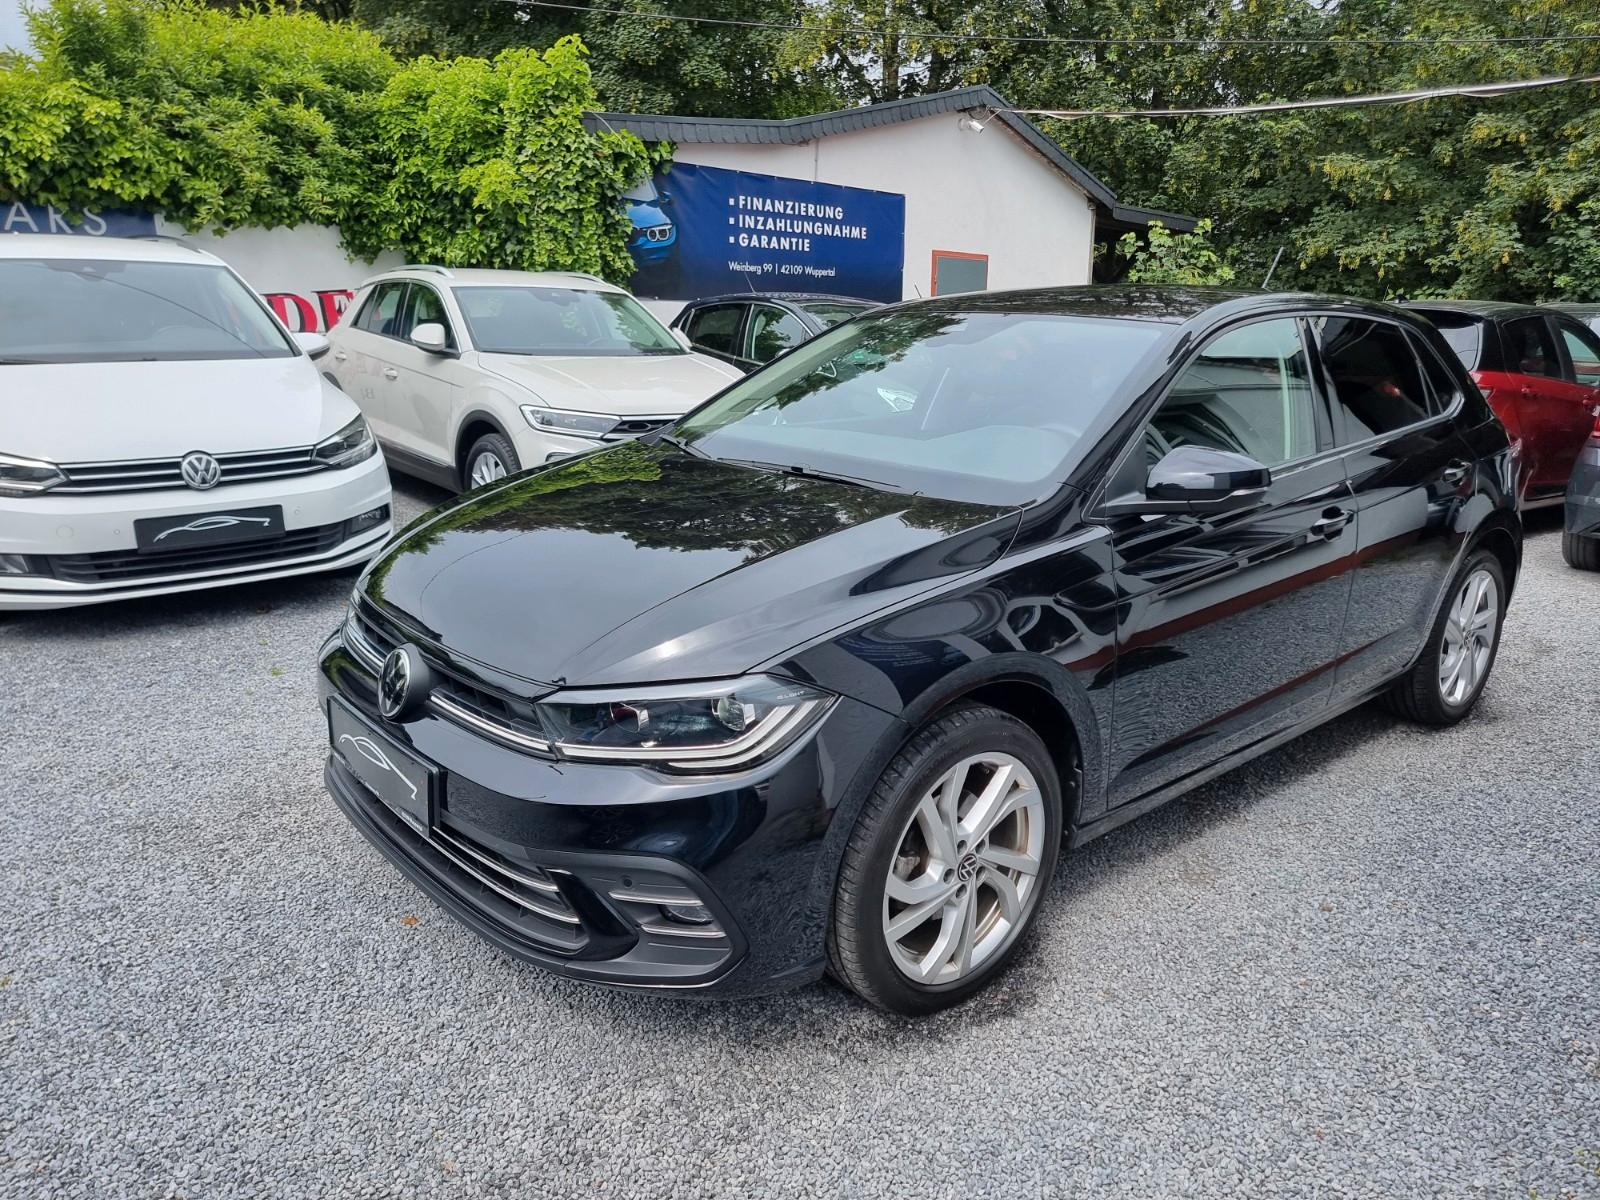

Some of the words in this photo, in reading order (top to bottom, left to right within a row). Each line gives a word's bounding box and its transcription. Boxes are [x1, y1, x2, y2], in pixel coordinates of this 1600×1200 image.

[739, 195, 844, 220] FINANZIERUNG
[739, 214, 867, 240] INZAHLUNGNAHME
[739, 233, 811, 252] GARANTIE
[728, 261, 762, 275] Weinberg
[763, 263, 773, 273] 99
[780, 265, 803, 275] 42109
[804, 266, 836, 279] Wuppertal
